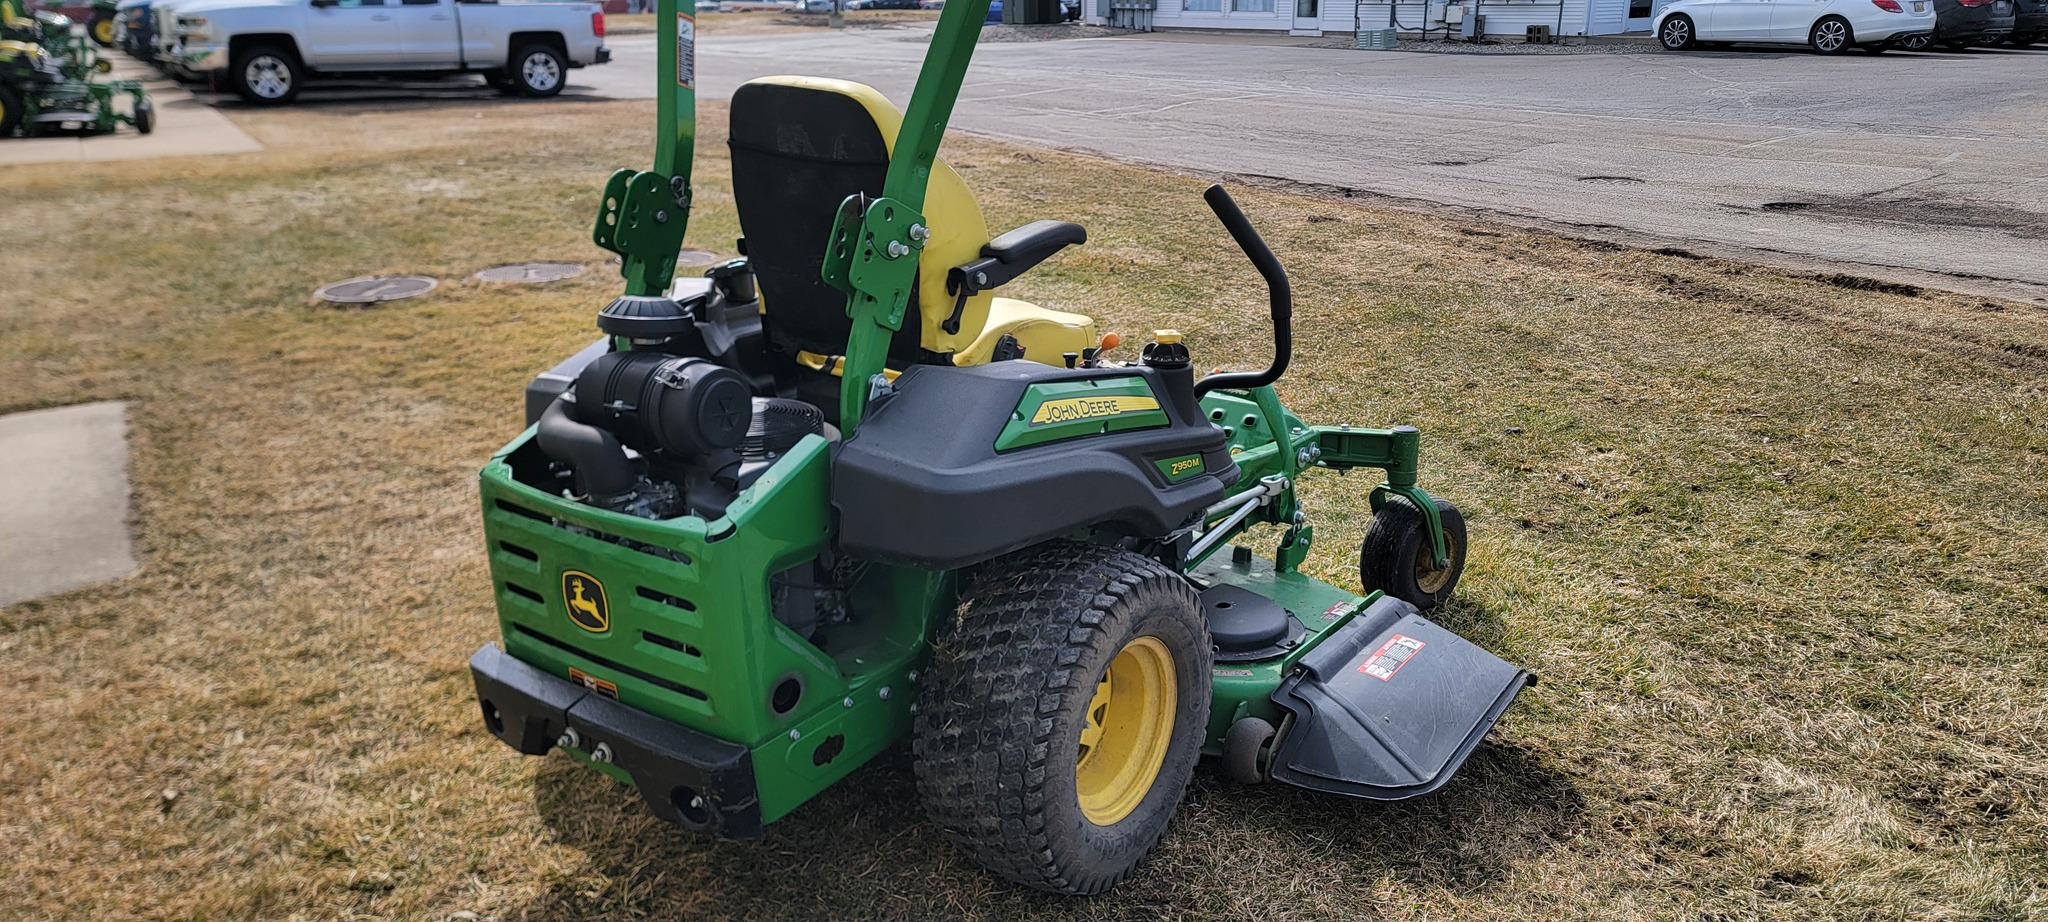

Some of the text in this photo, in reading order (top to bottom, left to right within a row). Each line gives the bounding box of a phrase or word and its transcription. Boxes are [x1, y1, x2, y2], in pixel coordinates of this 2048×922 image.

[1045, 400, 1120, 421] JOHN DEERE
[1171, 457, 1200, 475] Z950M
